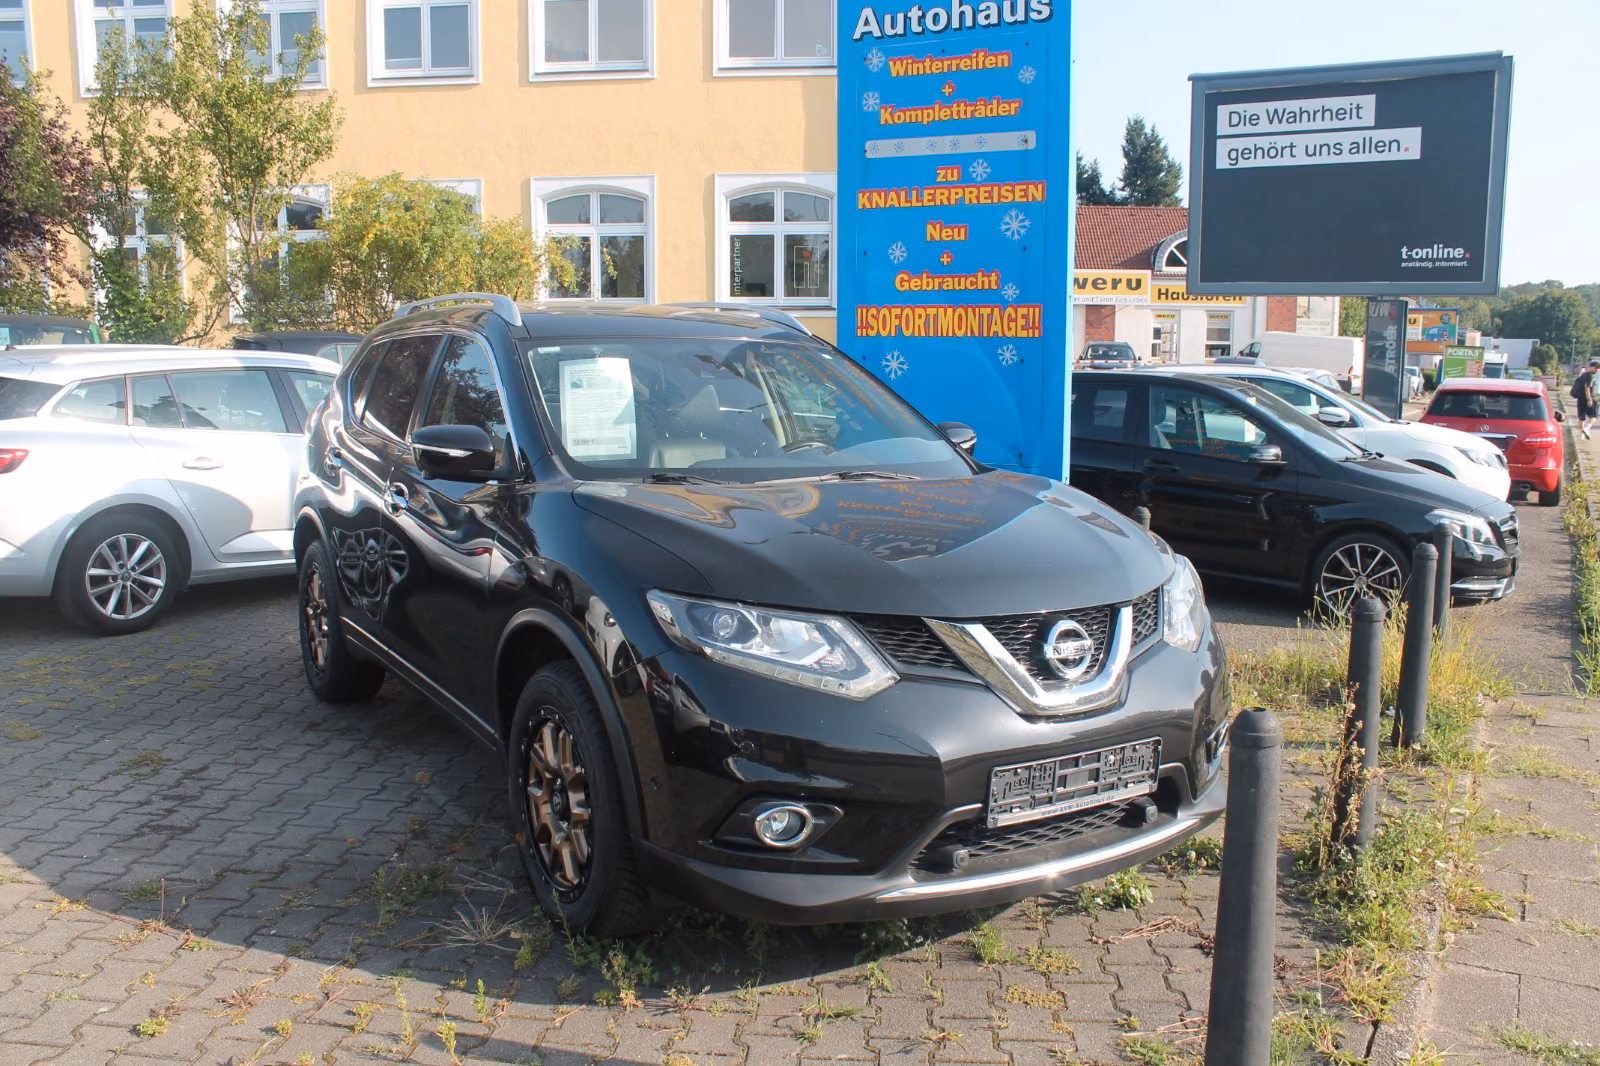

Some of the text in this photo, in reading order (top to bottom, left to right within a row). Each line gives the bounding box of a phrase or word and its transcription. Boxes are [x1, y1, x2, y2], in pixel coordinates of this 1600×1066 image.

[852, 0, 1053, 41] Autohaus
[888, 50, 1011, 78] Winterreifen
[880, 97, 1022, 126] Kompletträder
[1227, 102, 1364, 128] Die Wahrheit
[1227, 136, 1411, 166] gehört uns allen.
[936, 166, 961, 183] zu
[857, 182, 1045, 210] KNALLERPREISEN
[926, 222, 968, 242] Neu
[895, 270, 1000, 291] Gebraucht
[856, 305, 1042, 338] !!SOFORTMONTAGE!!
[1052, 643, 1091, 657] NISSAN
